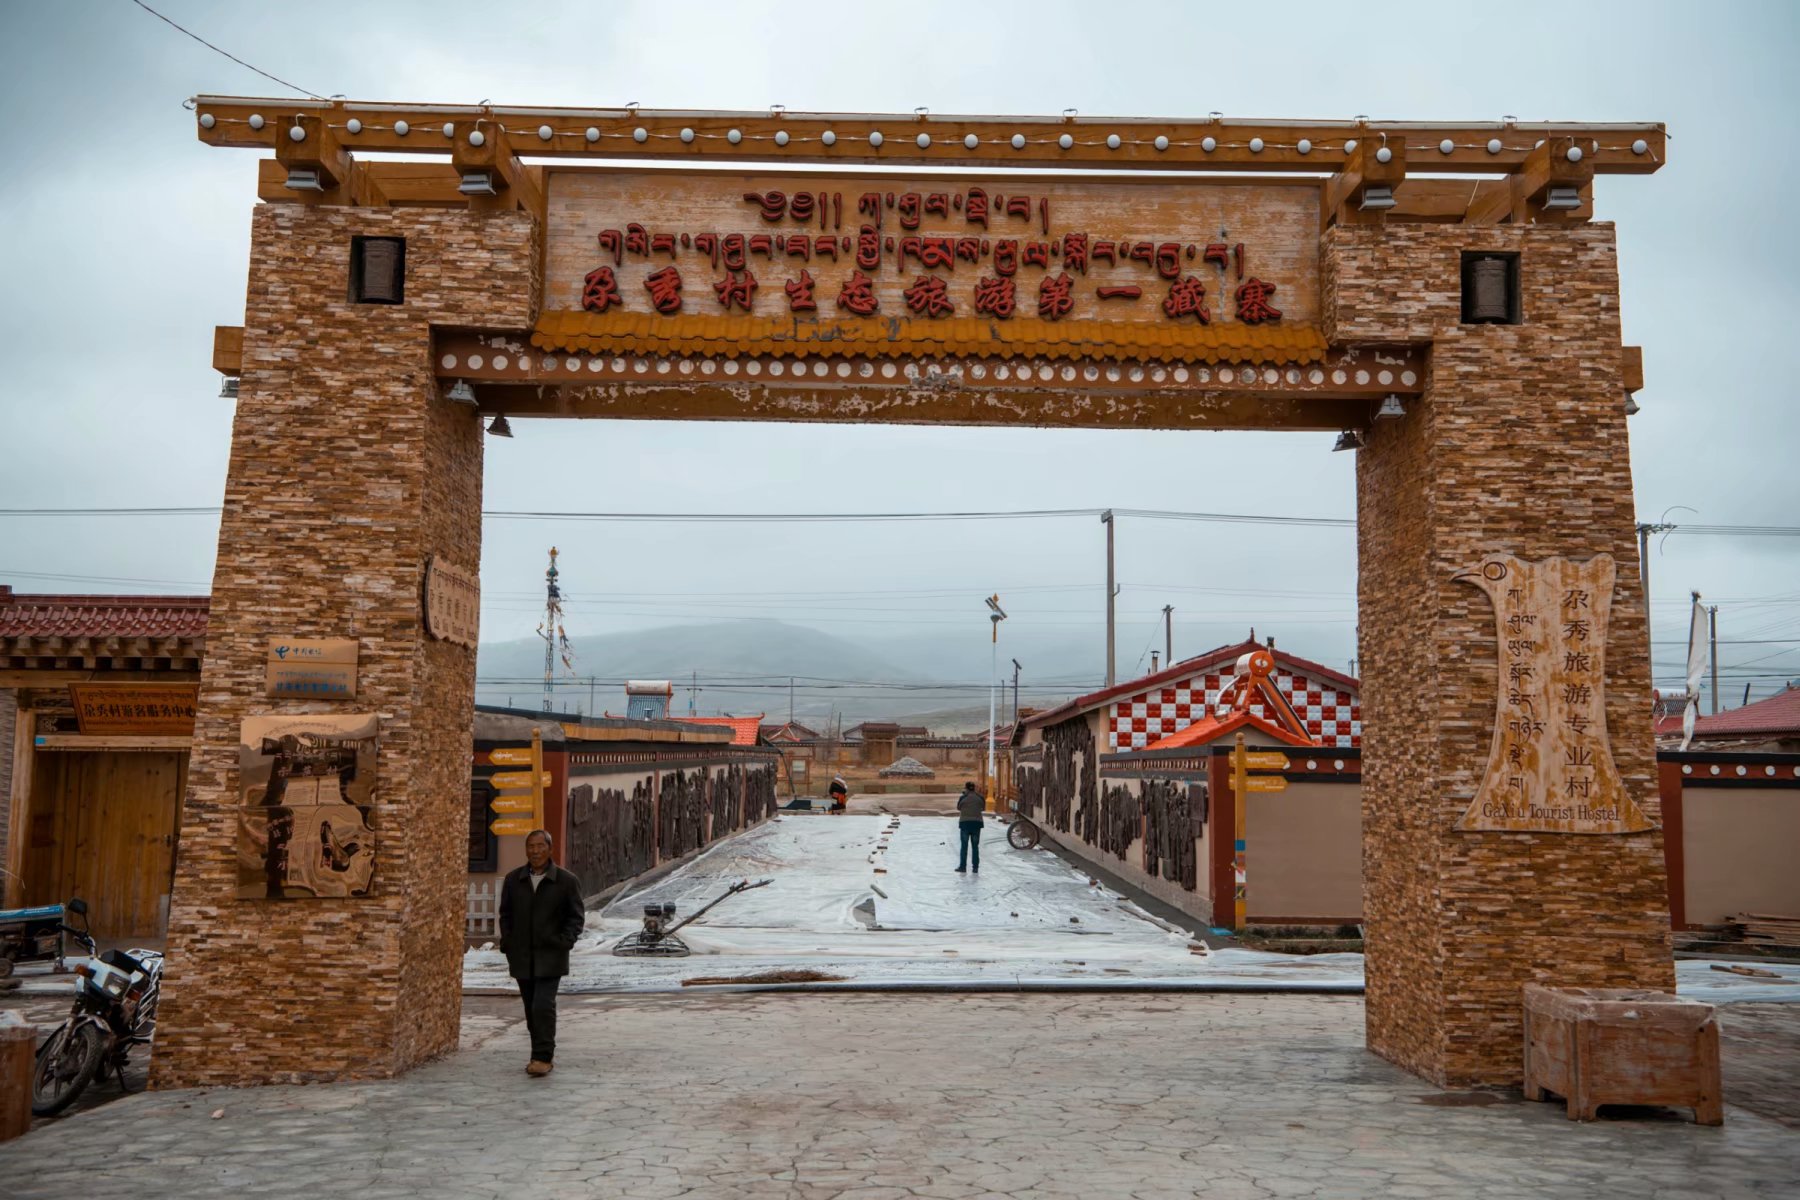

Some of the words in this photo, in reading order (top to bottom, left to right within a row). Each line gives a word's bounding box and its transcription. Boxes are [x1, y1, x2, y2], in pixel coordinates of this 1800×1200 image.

[581, 266, 1283, 325] 尕秀村生态旅游第一藏寨
[1562, 589, 1593, 798] 尕秀旅游专业村
[1529, 804, 1575, 819] Tourist
[1578, 806, 1621, 821] Hostel
